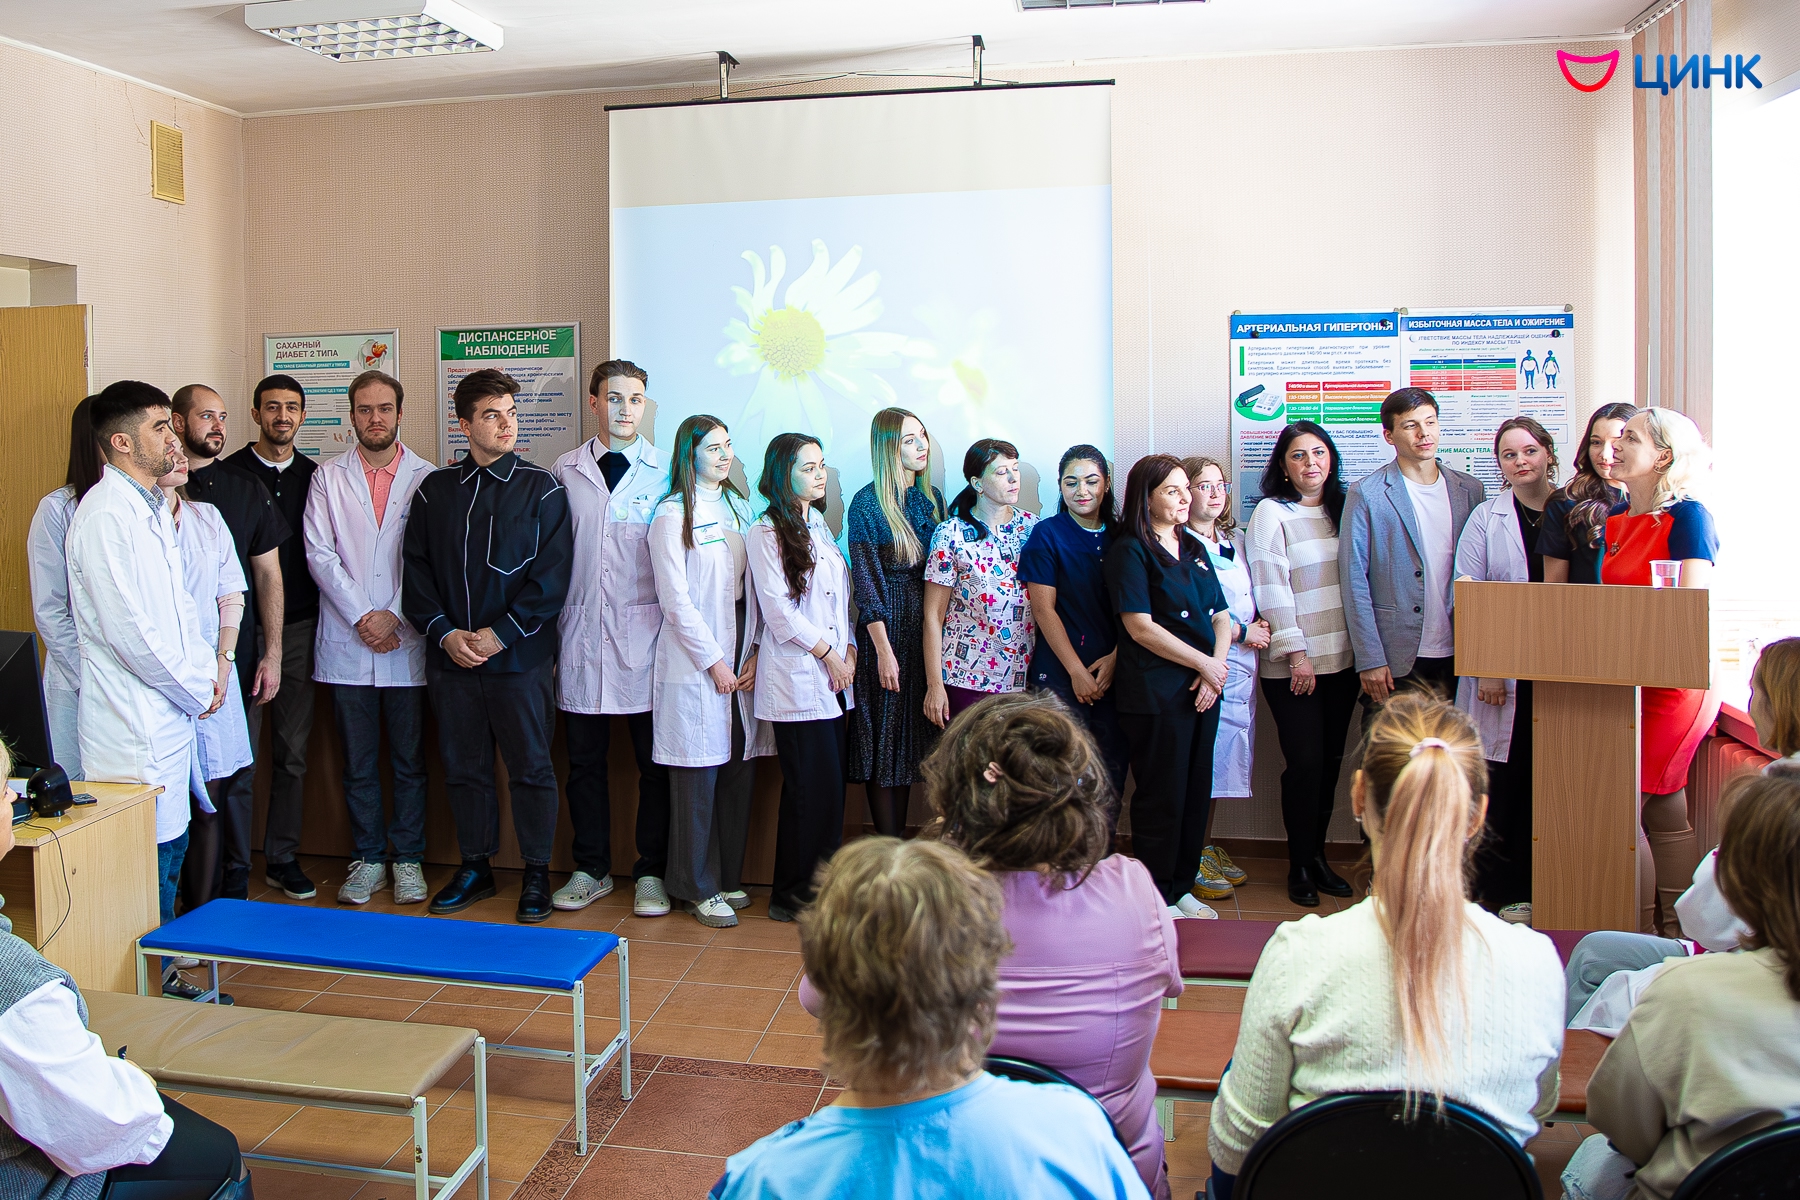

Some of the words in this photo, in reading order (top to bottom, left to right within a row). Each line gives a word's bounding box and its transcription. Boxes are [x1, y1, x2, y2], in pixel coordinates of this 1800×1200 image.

[1236, 323, 1321, 333] АРТЕРИАЛЬНАЯ
[1408, 320, 1462, 329] ИЗБЫТОЧНАЯ
[1463, 319, 1492, 327] МАССА
[1493, 319, 1513, 327] ТЕЛА
[1521, 318, 1566, 326] ОЖИРЕНИЕ
[457, 330, 557, 345] ДИСПАНСЕРНОЕ
[275, 340, 321, 350] САХАРНЫЙ
[275, 350, 308, 360] ДИАБЕТ
[465, 344, 550, 357] НАБЛЮДЕНИЕ
